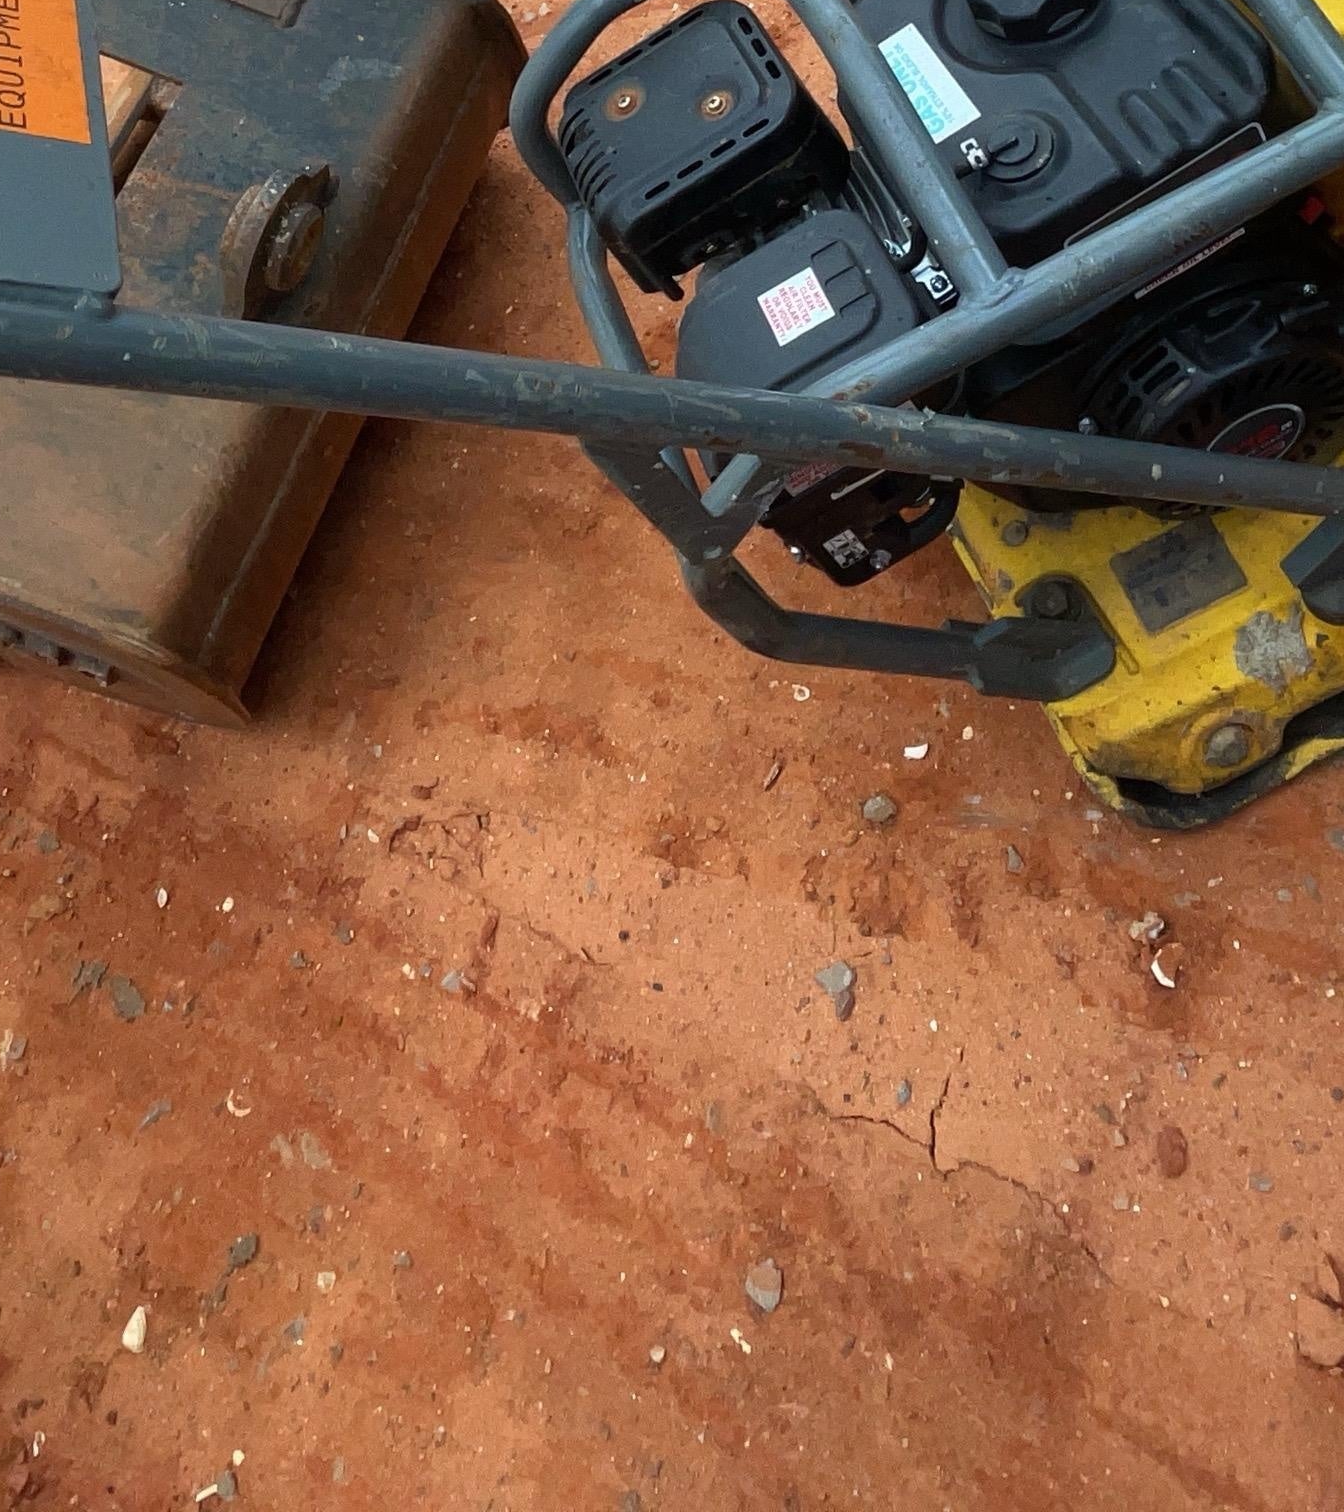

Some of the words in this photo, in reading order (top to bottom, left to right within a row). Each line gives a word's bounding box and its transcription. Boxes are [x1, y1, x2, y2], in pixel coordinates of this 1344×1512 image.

[916, 95, 945, 135] GAS
[806, 275, 817, 291] YOU
[813, 291, 828, 312] MUST
